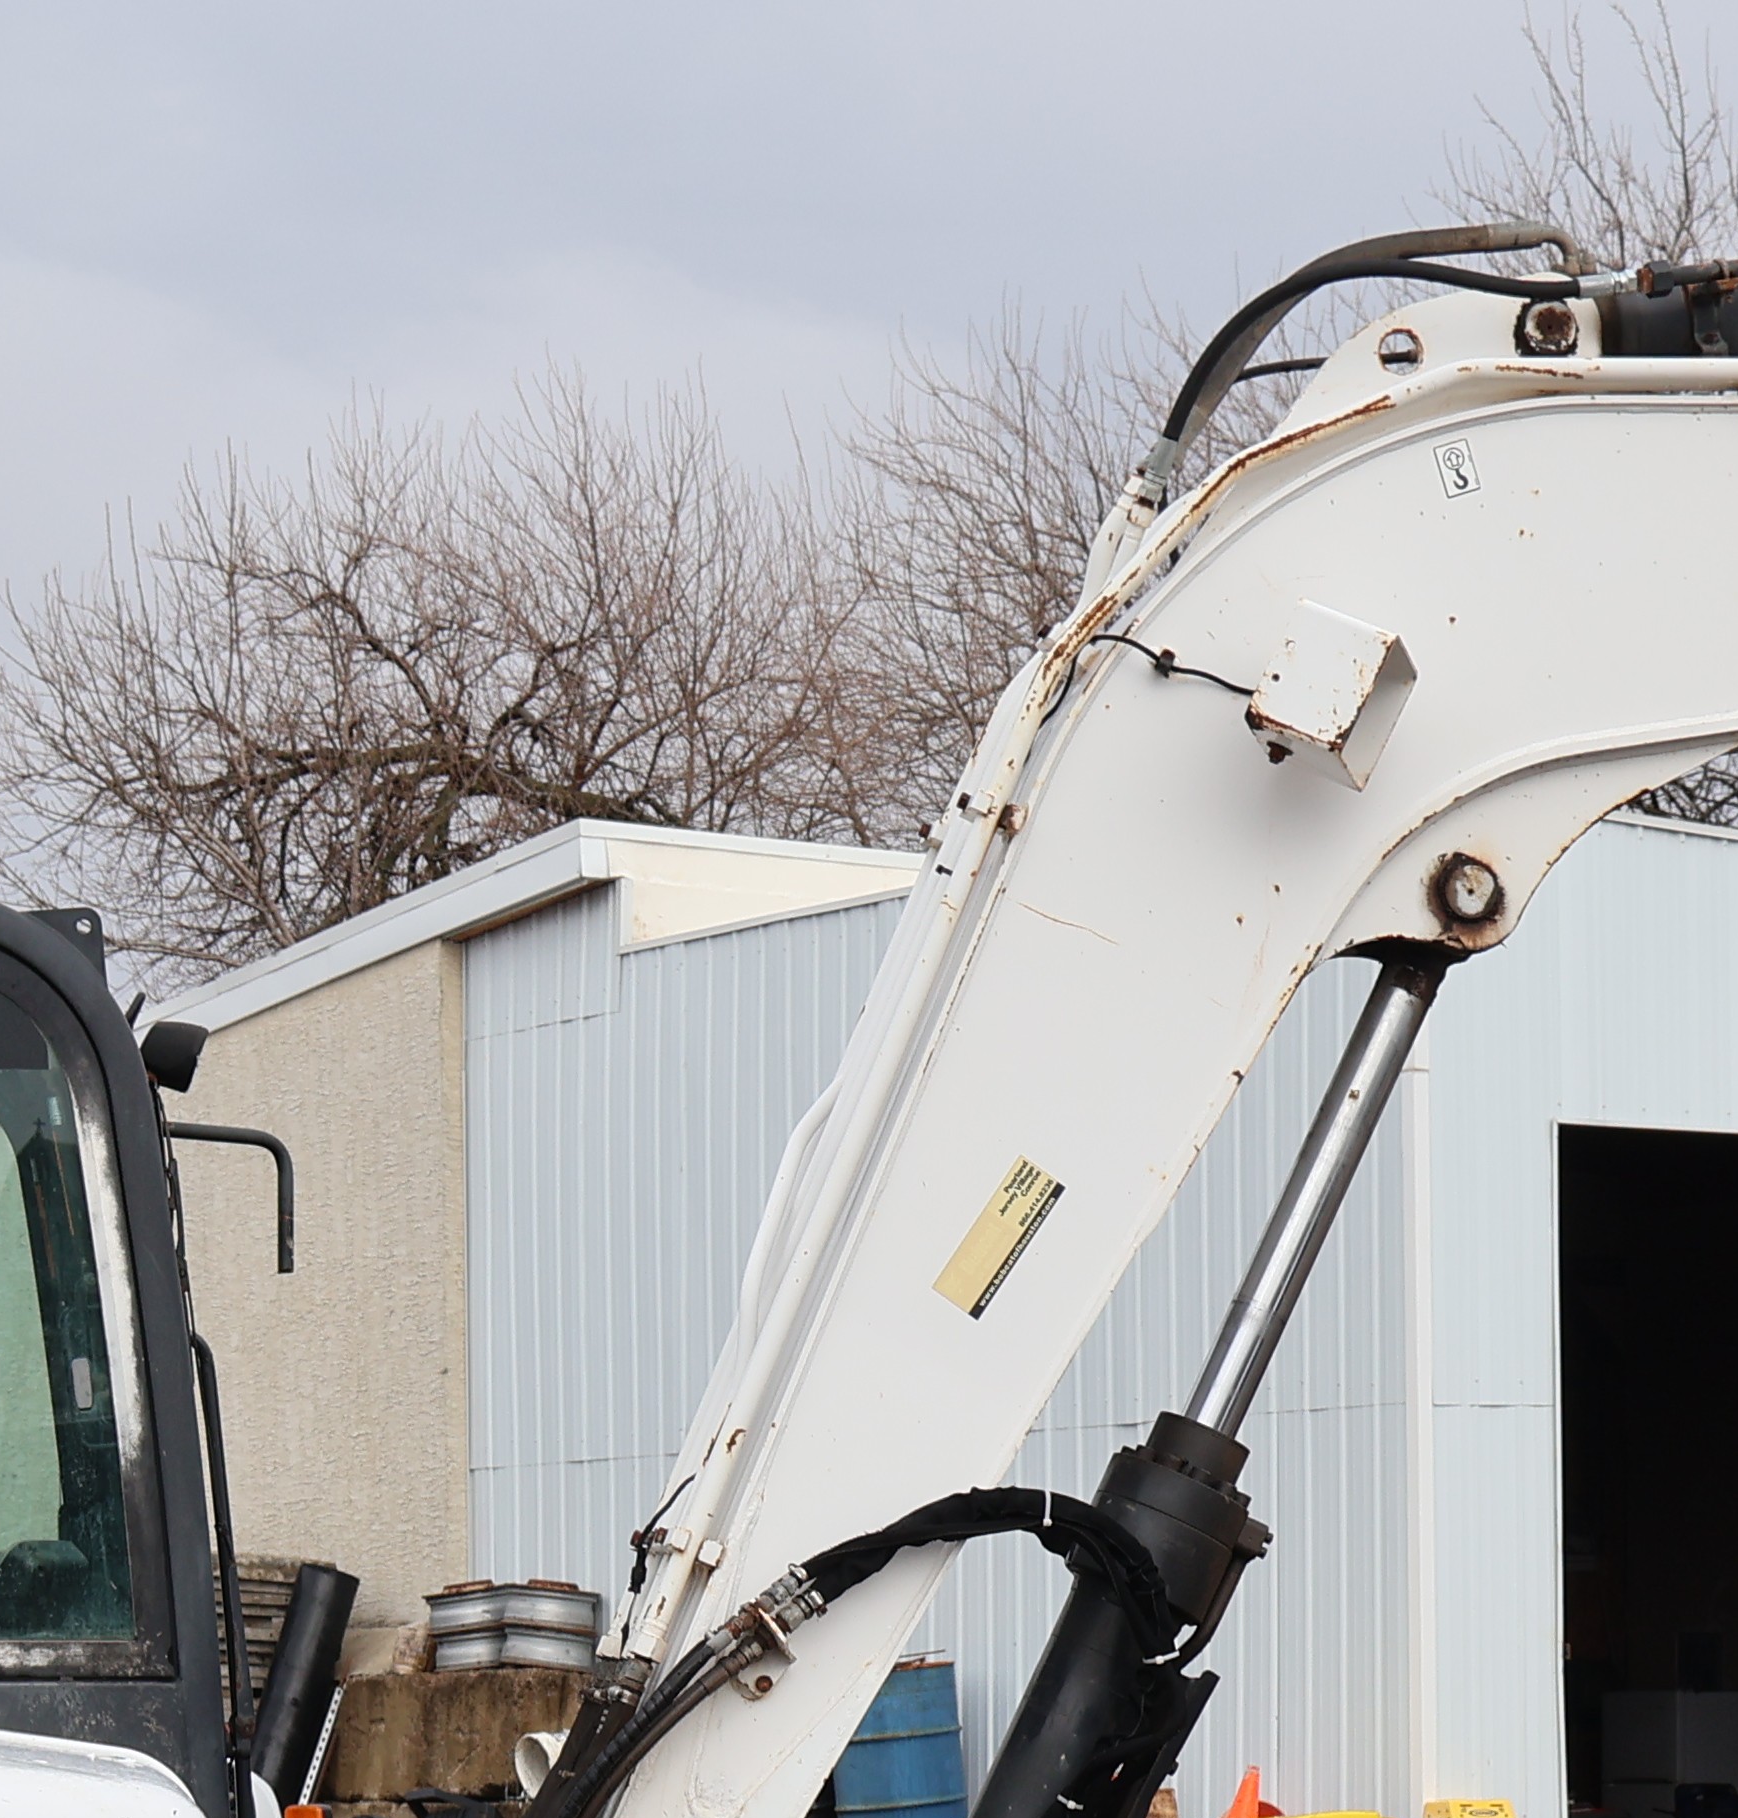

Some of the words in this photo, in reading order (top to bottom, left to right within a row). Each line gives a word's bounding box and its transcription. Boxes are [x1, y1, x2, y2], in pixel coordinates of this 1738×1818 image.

[998, 1192, 1019, 1217] Jersey
[1014, 1166, 1035, 1192] Village
[1003, 1159, 1029, 1194] Pearland
[1021, 1170, 1042, 1198] Conroe
[979, 1197, 1057, 1307] www.bobcatofhouston.com
